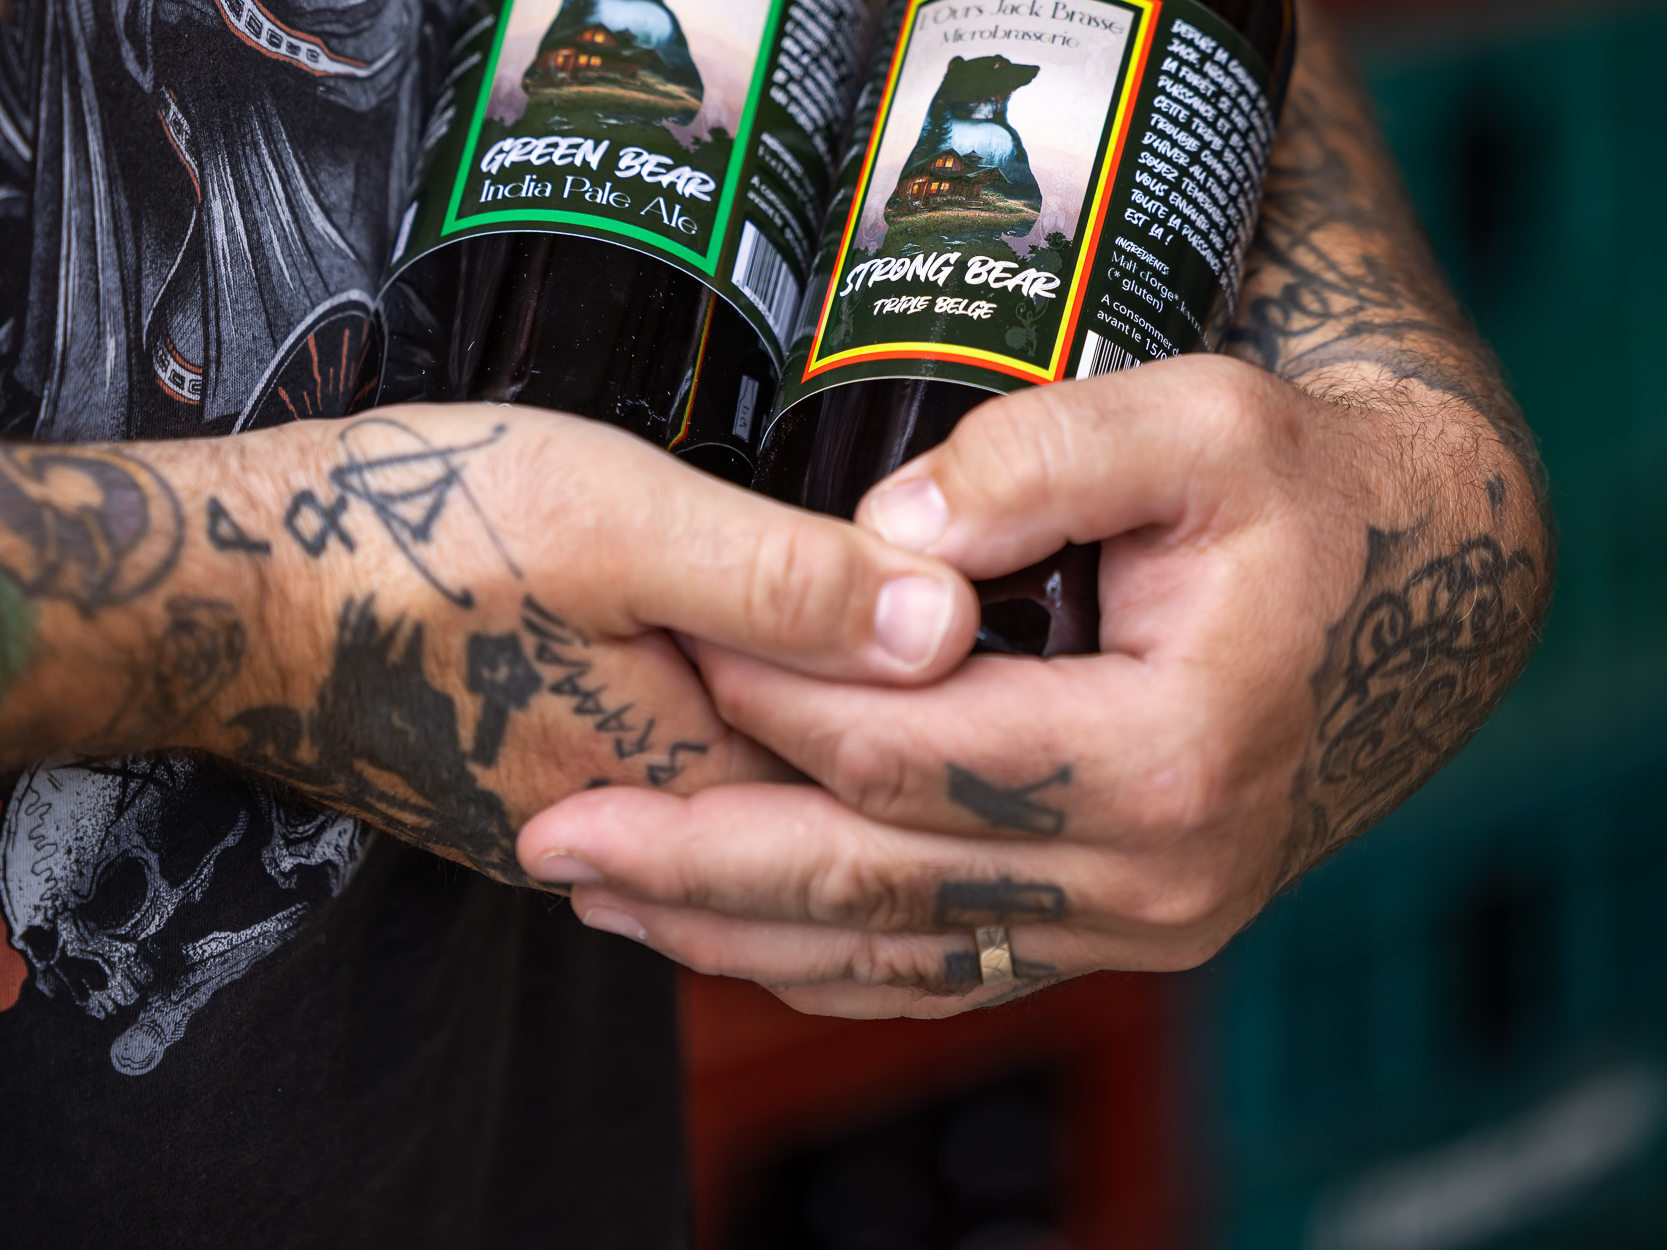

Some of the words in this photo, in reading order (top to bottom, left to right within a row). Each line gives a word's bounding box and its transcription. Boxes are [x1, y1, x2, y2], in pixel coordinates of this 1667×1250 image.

[1050, 1, 1125, 35] Brasse
[941, 24, 1080, 49] Microbrasserie
[1153, 94, 1191, 123] CETTE
[1157, 74, 1218, 123] PUISSANCE
[1150, 112, 1202, 152] TROUBLE
[480, 135, 611, 175] GREEN
[614, 146, 717, 202] BEAR
[1137, 151, 1180, 183] SOYEZ
[1188, 164, 1208, 186] AU
[479, 174, 553, 203] India
[562, 175, 631, 208] Pale
[639, 196, 698, 235] Ale
[1124, 208, 1151, 227] EST
[1135, 170, 1169, 197] VOUS
[1168, 191, 1211, 232] ENVAHIR
[1131, 188, 1169, 219] TOUTE
[1167, 214, 1182, 231] LA
[1181, 224, 1222, 276] PUISSANCE
[839, 251, 962, 297] STRONG
[964, 255, 1061, 299] BEAR
[1111, 250, 1139, 274] Malt
[873, 295, 933, 317] TRIPLE
[934, 296, 998, 321] BELGE
[1121, 278, 1164, 313] gluten)
[1097, 310, 1131, 336] avant
[1131, 327, 1142, 343] le
[1100, 293, 1111, 307] A
[1112, 301, 1173, 350] consommer
